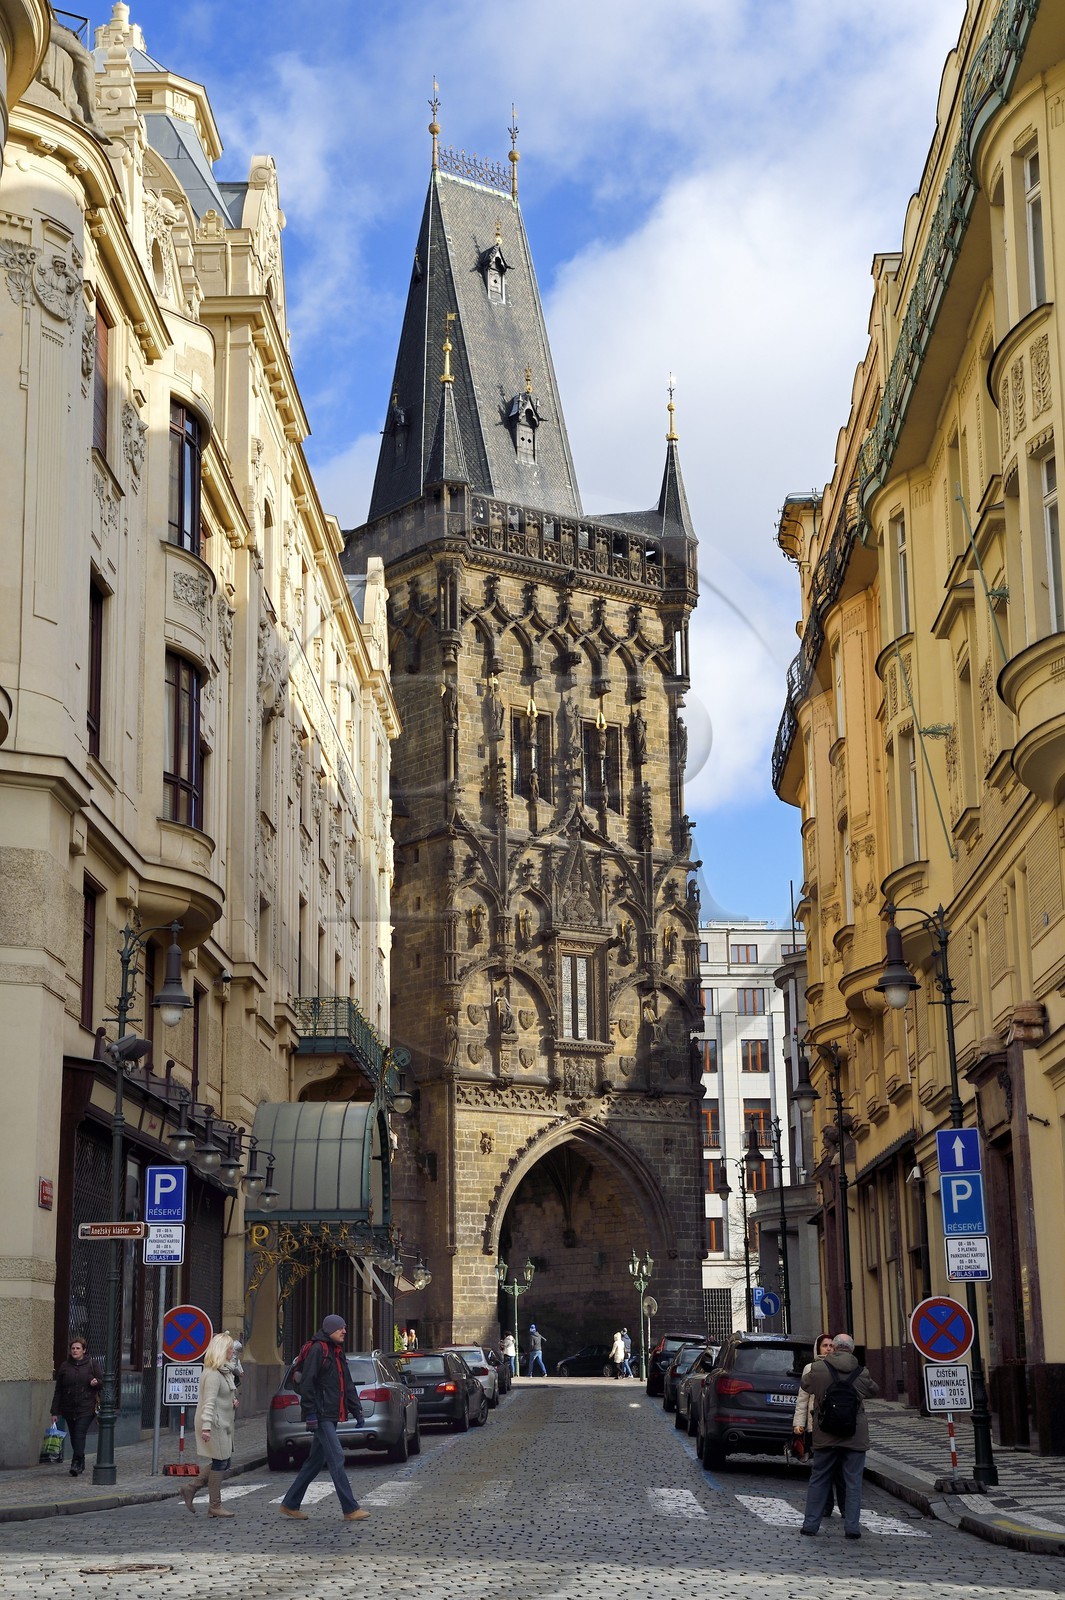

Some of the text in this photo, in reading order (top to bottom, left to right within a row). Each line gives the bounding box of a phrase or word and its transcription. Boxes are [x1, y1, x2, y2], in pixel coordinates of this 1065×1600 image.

[154, 1173, 177, 1205] P
[951, 1179, 973, 1214] P
[148, 1208, 182, 1216] RÉSERVÉ
[948, 1222, 983, 1232] RÉSERVÉ
[756, 1290, 762, 1300] P
[936, 1369, 957, 1378] ČIŠTĚNÍ
[930, 1379, 966, 1387] KOMUNIKACE
[948, 1388, 964, 1396] 2015
